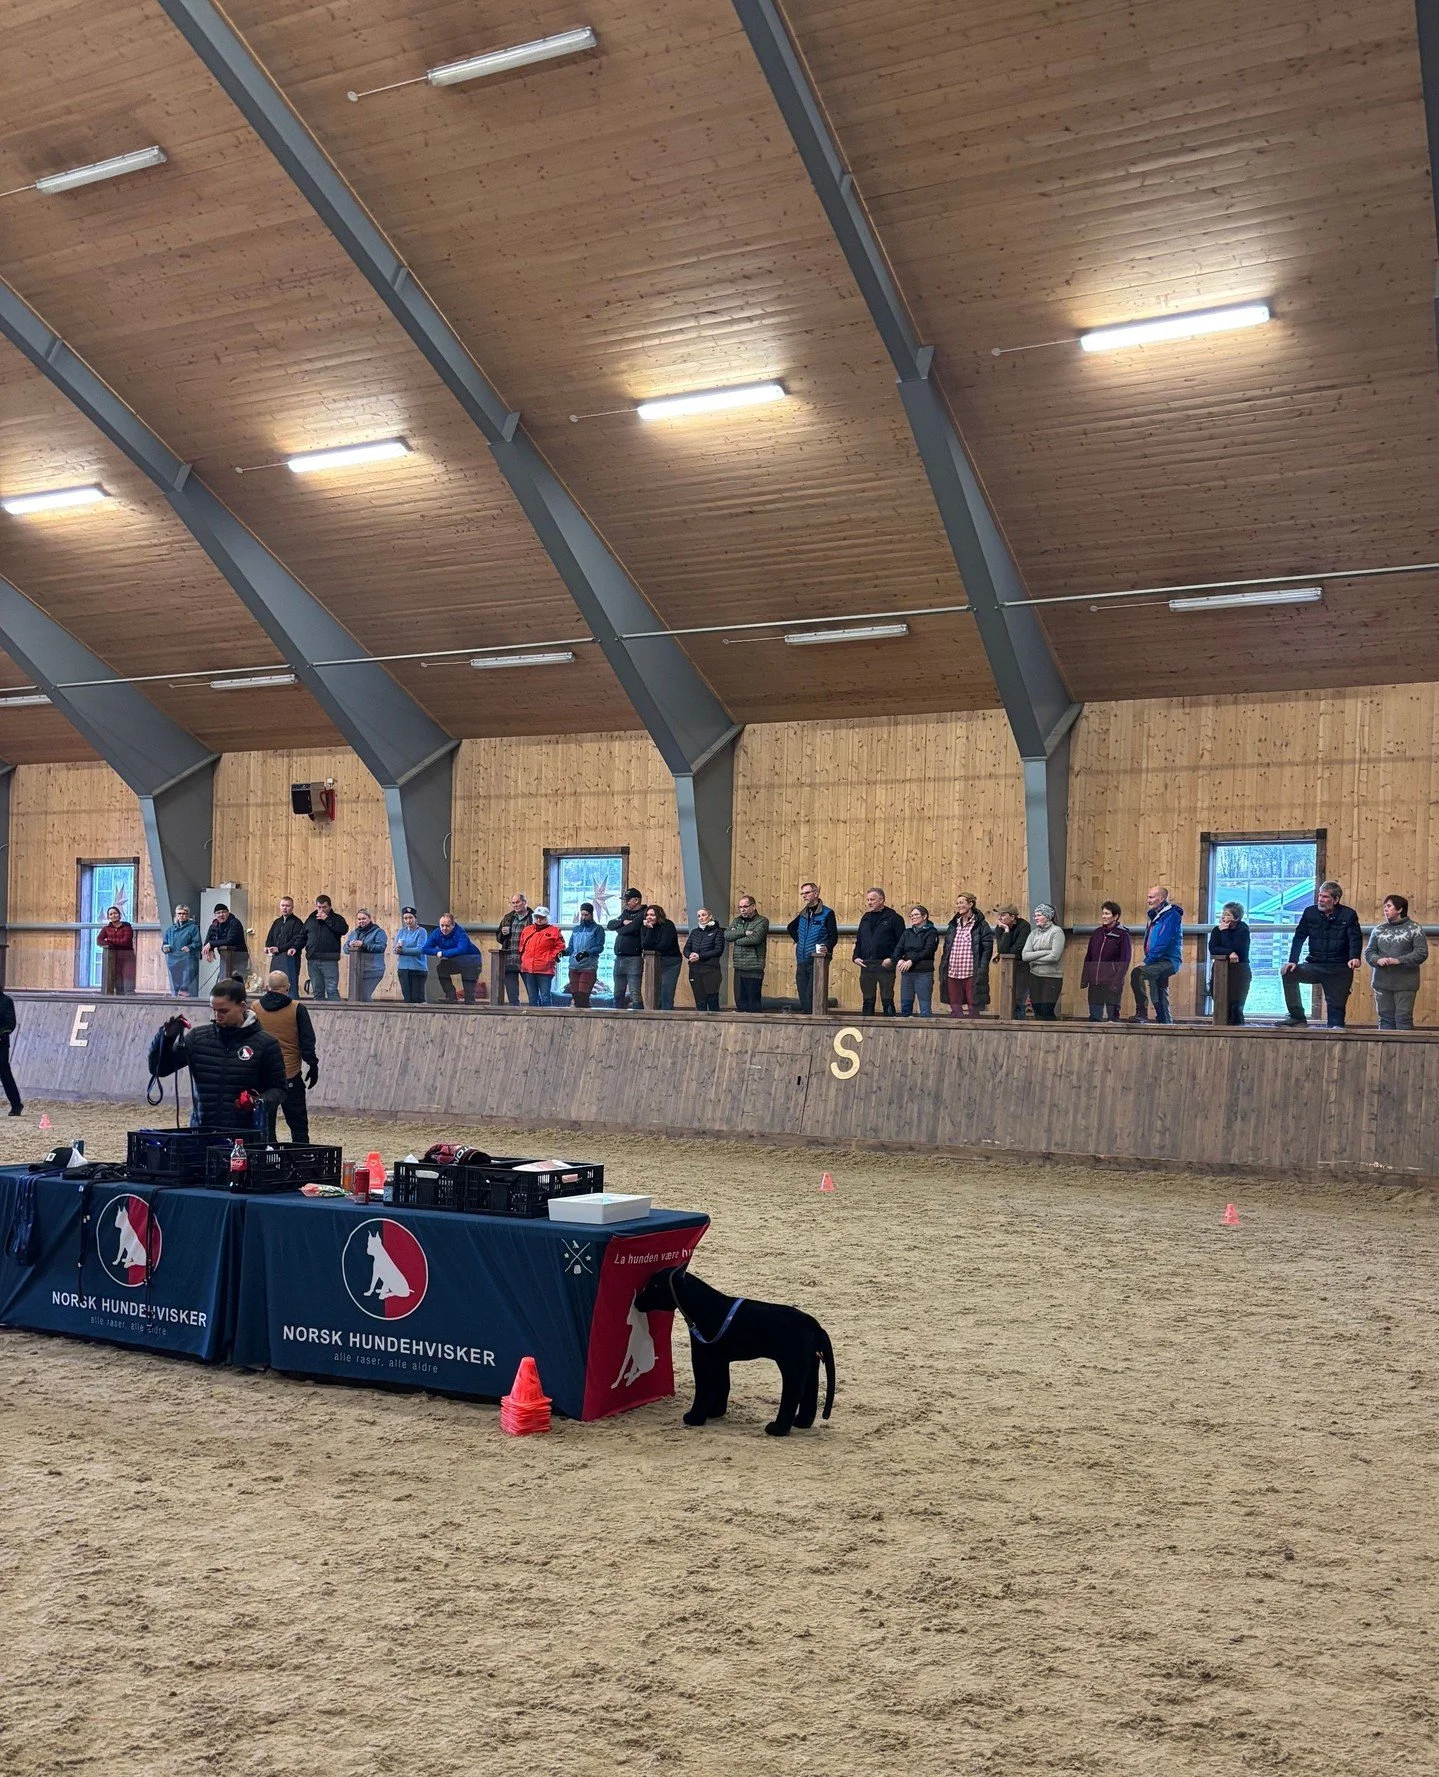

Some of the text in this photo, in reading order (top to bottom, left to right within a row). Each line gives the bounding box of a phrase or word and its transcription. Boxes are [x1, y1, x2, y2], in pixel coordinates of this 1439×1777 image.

[69, 1004, 96, 1047] E
[830, 1027, 863, 1080] S
[614, 1254, 626, 1265] La
[627, 1253, 659, 1264] hunden
[661, 1250, 680, 1261] være
[52, 1291, 207, 1327] NORSK HUNDEHVISKER
[90, 1315, 103, 1325] alle
[130, 1322, 144, 1332] alle
[283, 1325, 496, 1367] NORSK HUNDEHVISKER
[334, 1351, 352, 1362] alle
[389, 1358, 408, 1370] alle
[412, 1361, 438, 1373] aldre
